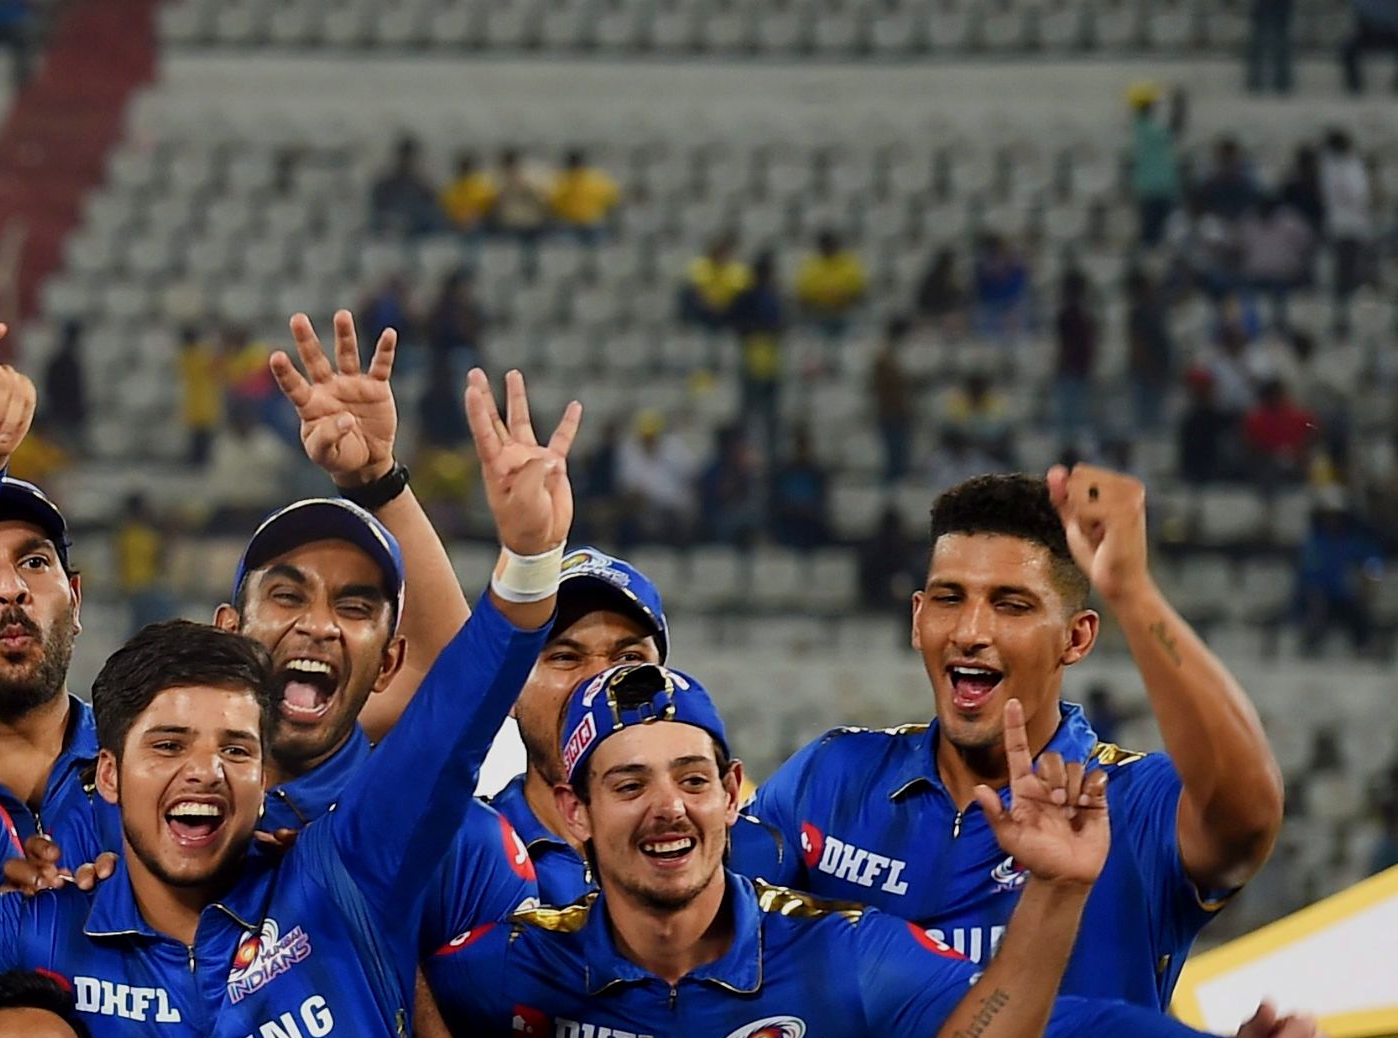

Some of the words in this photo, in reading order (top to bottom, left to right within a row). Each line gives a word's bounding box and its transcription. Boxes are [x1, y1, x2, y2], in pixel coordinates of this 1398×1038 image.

[819, 836, 909, 896] DHFL
[74, 976, 181, 1022] DHFL
[228, 940, 312, 1004] INDIANS
